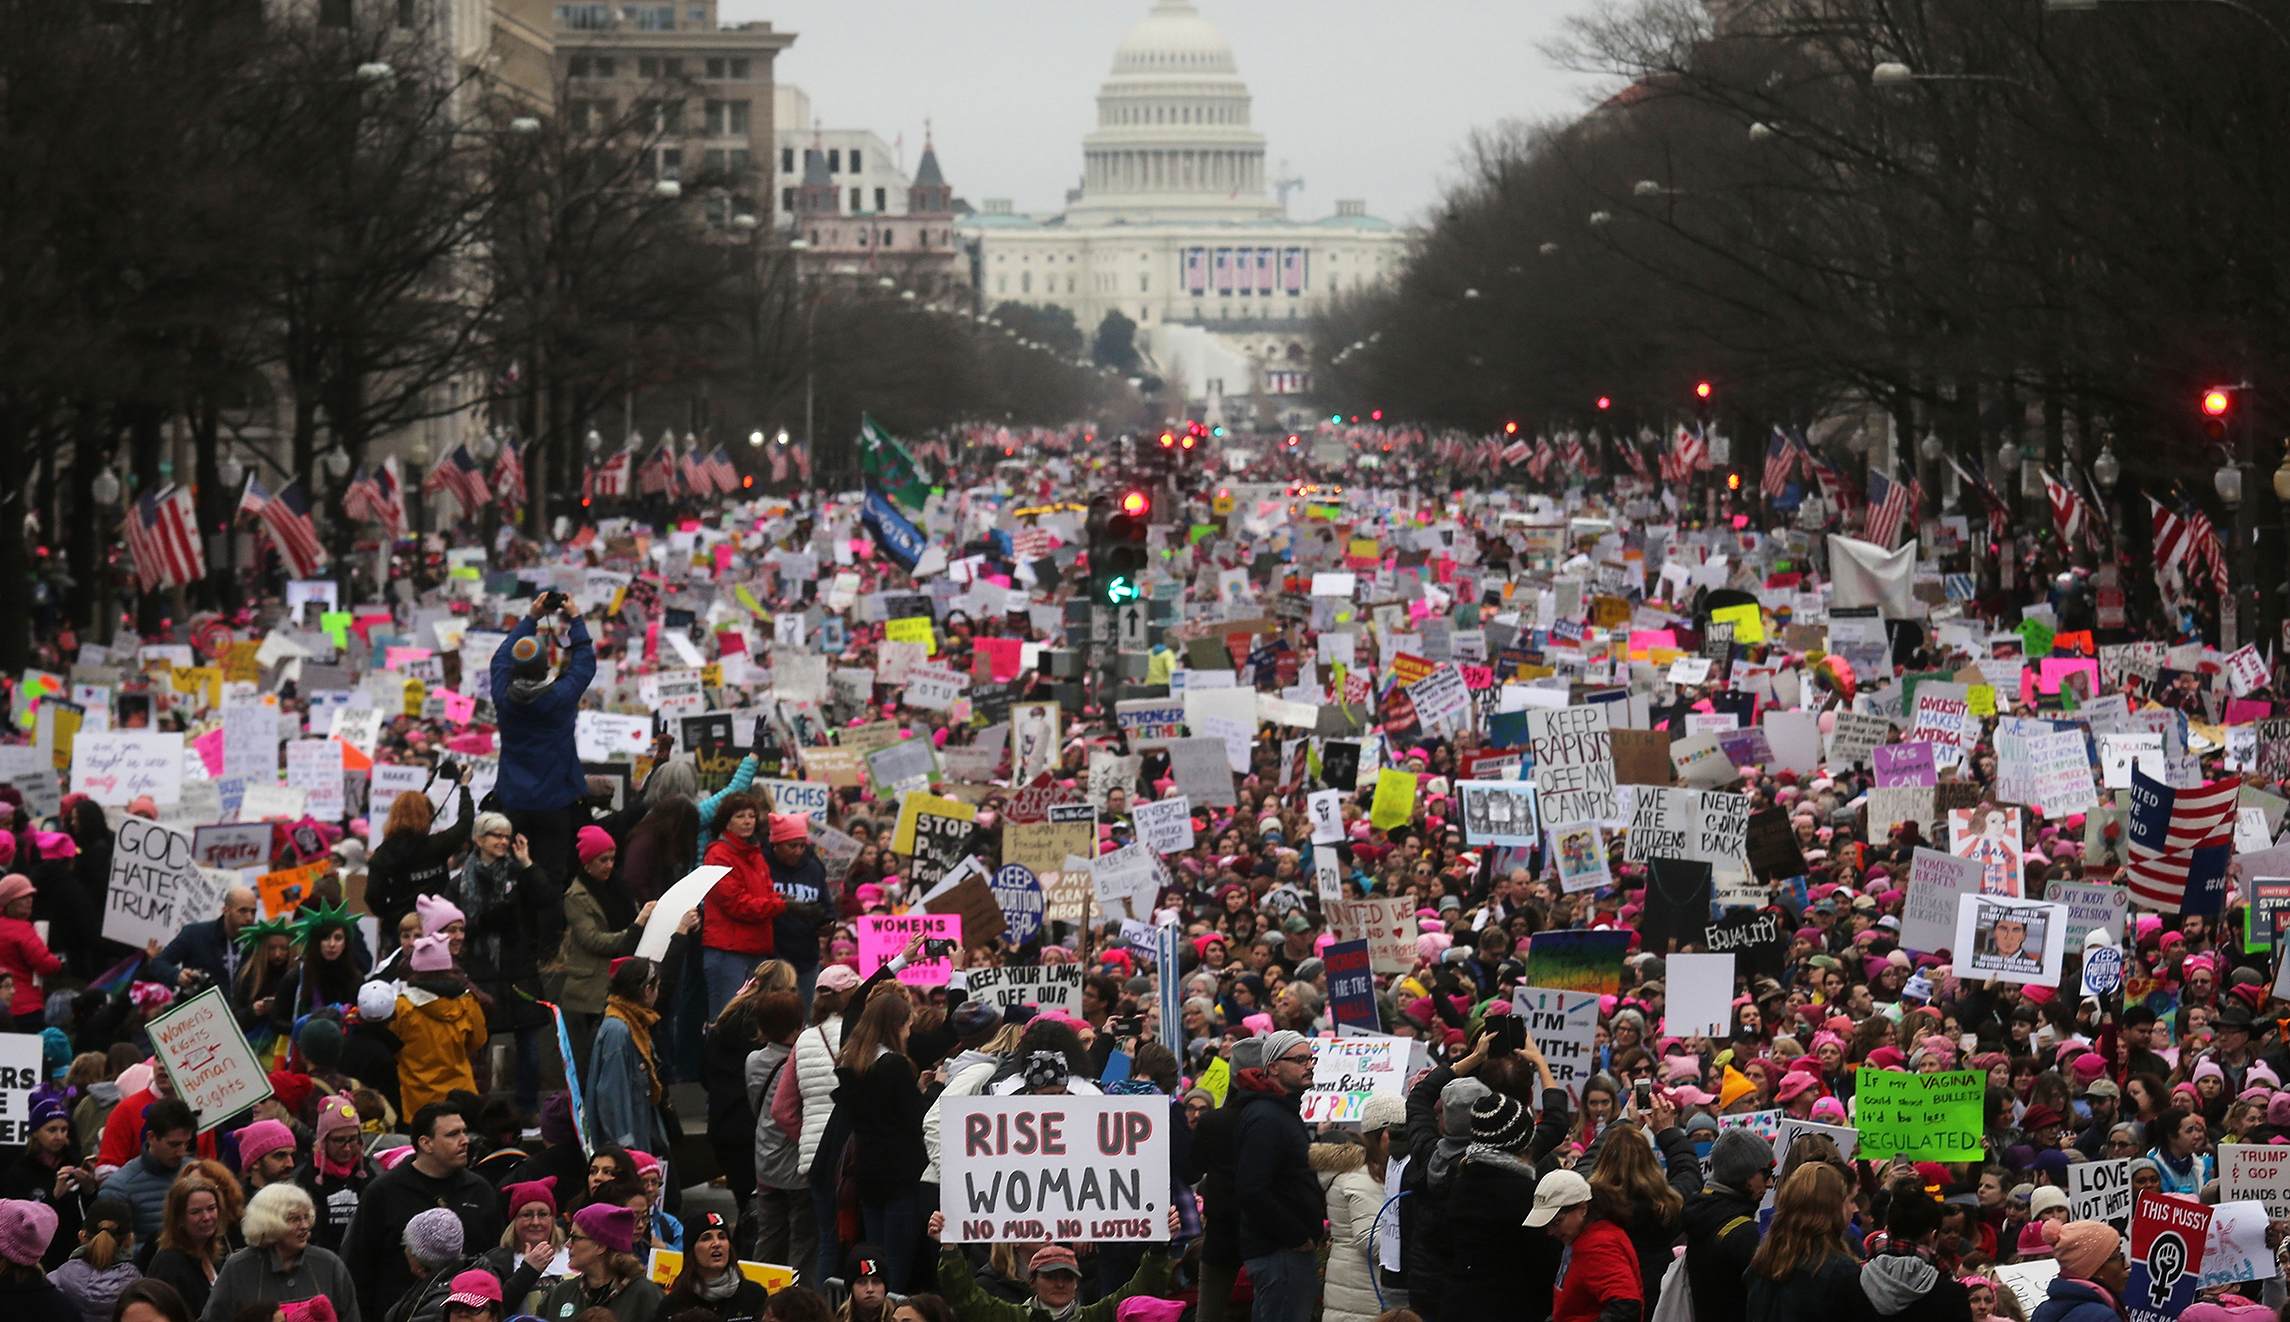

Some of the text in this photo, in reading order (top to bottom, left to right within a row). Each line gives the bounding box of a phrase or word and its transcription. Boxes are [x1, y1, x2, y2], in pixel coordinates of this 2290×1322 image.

[1920, 697, 1968, 716] DIVERSITY
[1117, 709, 1185, 730] STRONGER
[1545, 709, 1597, 736] KEEP
[1919, 712, 1961, 730] MAKES
[2003, 719, 2026, 737] WE
[1914, 728, 1961, 747] AMERICA
[1532, 732, 1613, 766] RAPISTS
[1885, 746, 1917, 762] Yes
[1932, 747, 1956, 763] EAT
[1541, 765, 1613, 796] OFF MY
[1889, 774, 1921, 787] CAN
[774, 783, 826, 807] TCHES
[1637, 789, 1668, 811] WE
[1701, 793, 1749, 815] NEVER
[2131, 785, 2159, 807] ITED
[1543, 791, 1618, 824] CAMPUS
[917, 814, 973, 839] STOP
[1632, 811, 1665, 828] ARE
[1705, 815, 1748, 837] GOING
[1029, 825, 1060, 836] WANT
[1631, 831, 1686, 848] CITIZENS
[119, 819, 190, 871] GOD
[1702, 832, 1743, 860] BACK
[1970, 847, 2013, 863] OMAN'S
[1916, 855, 1964, 877] WOMEN'S
[998, 872, 1031, 888] KEEP
[1062, 872, 1089, 887] MY
[1913, 881, 1936, 894] ARE
[1915, 870, 1957, 889] RIGHTS
[1910, 896, 1951, 912] HUMAN
[2063, 891, 2106, 906] MY BODY
[1324, 901, 1414, 926] UNITED WE
[1910, 908, 1951, 925] RIGHTS
[1981, 912, 2000, 920] START
[2067, 907, 2112, 921] DECISION
[872, 919, 945, 932] WOMENS
[1003, 911, 1037, 943] EGAL
[1705, 913, 1777, 952] EQUALITY
[1325, 951, 1370, 974] WOMEN
[2094, 950, 2116, 962] KEEP
[902, 970, 938, 980] GHTS
[967, 964, 1082, 992] KEEP YOUR LAWS
[998, 987, 1067, 1006] OFF OUR
[1335, 976, 1367, 998] ARE THE
[1338, 1000, 1371, 1023] WALL
[156, 1006, 214, 1044] Women's
[1532, 1013, 1564, 1031] I'M
[170, 1028, 211, 1056] RIGHTS
[182, 1057, 237, 1093] Human
[1547, 1063, 1574, 1081] ER
[1920, 1075, 1977, 1090] VAGINA
[195, 1078, 246, 1112] Rights
[1933, 1090, 1981, 1106] BULLETS
[1898, 1112, 1912, 1123] be
[965, 1111, 1153, 1157] RISE UP
[1858, 1131, 1976, 1151] REGULATED
[2241, 1150, 2288, 1163] TRUMP
[2080, 1161, 2129, 1193] LOVE
[2248, 1167, 2278, 1180] GOP
[965, 1167, 1155, 1213] WOMAN.
[2231, 1188, 2277, 1201] HANDS
[2071, 1189, 2129, 1221] NOT HATE
[2265, 1206, 2290, 1218] MEN
[2141, 1200, 2210, 1232] THIS PUSSY
[963, 1218, 1151, 1241] NO MUD, NO LOTUS
